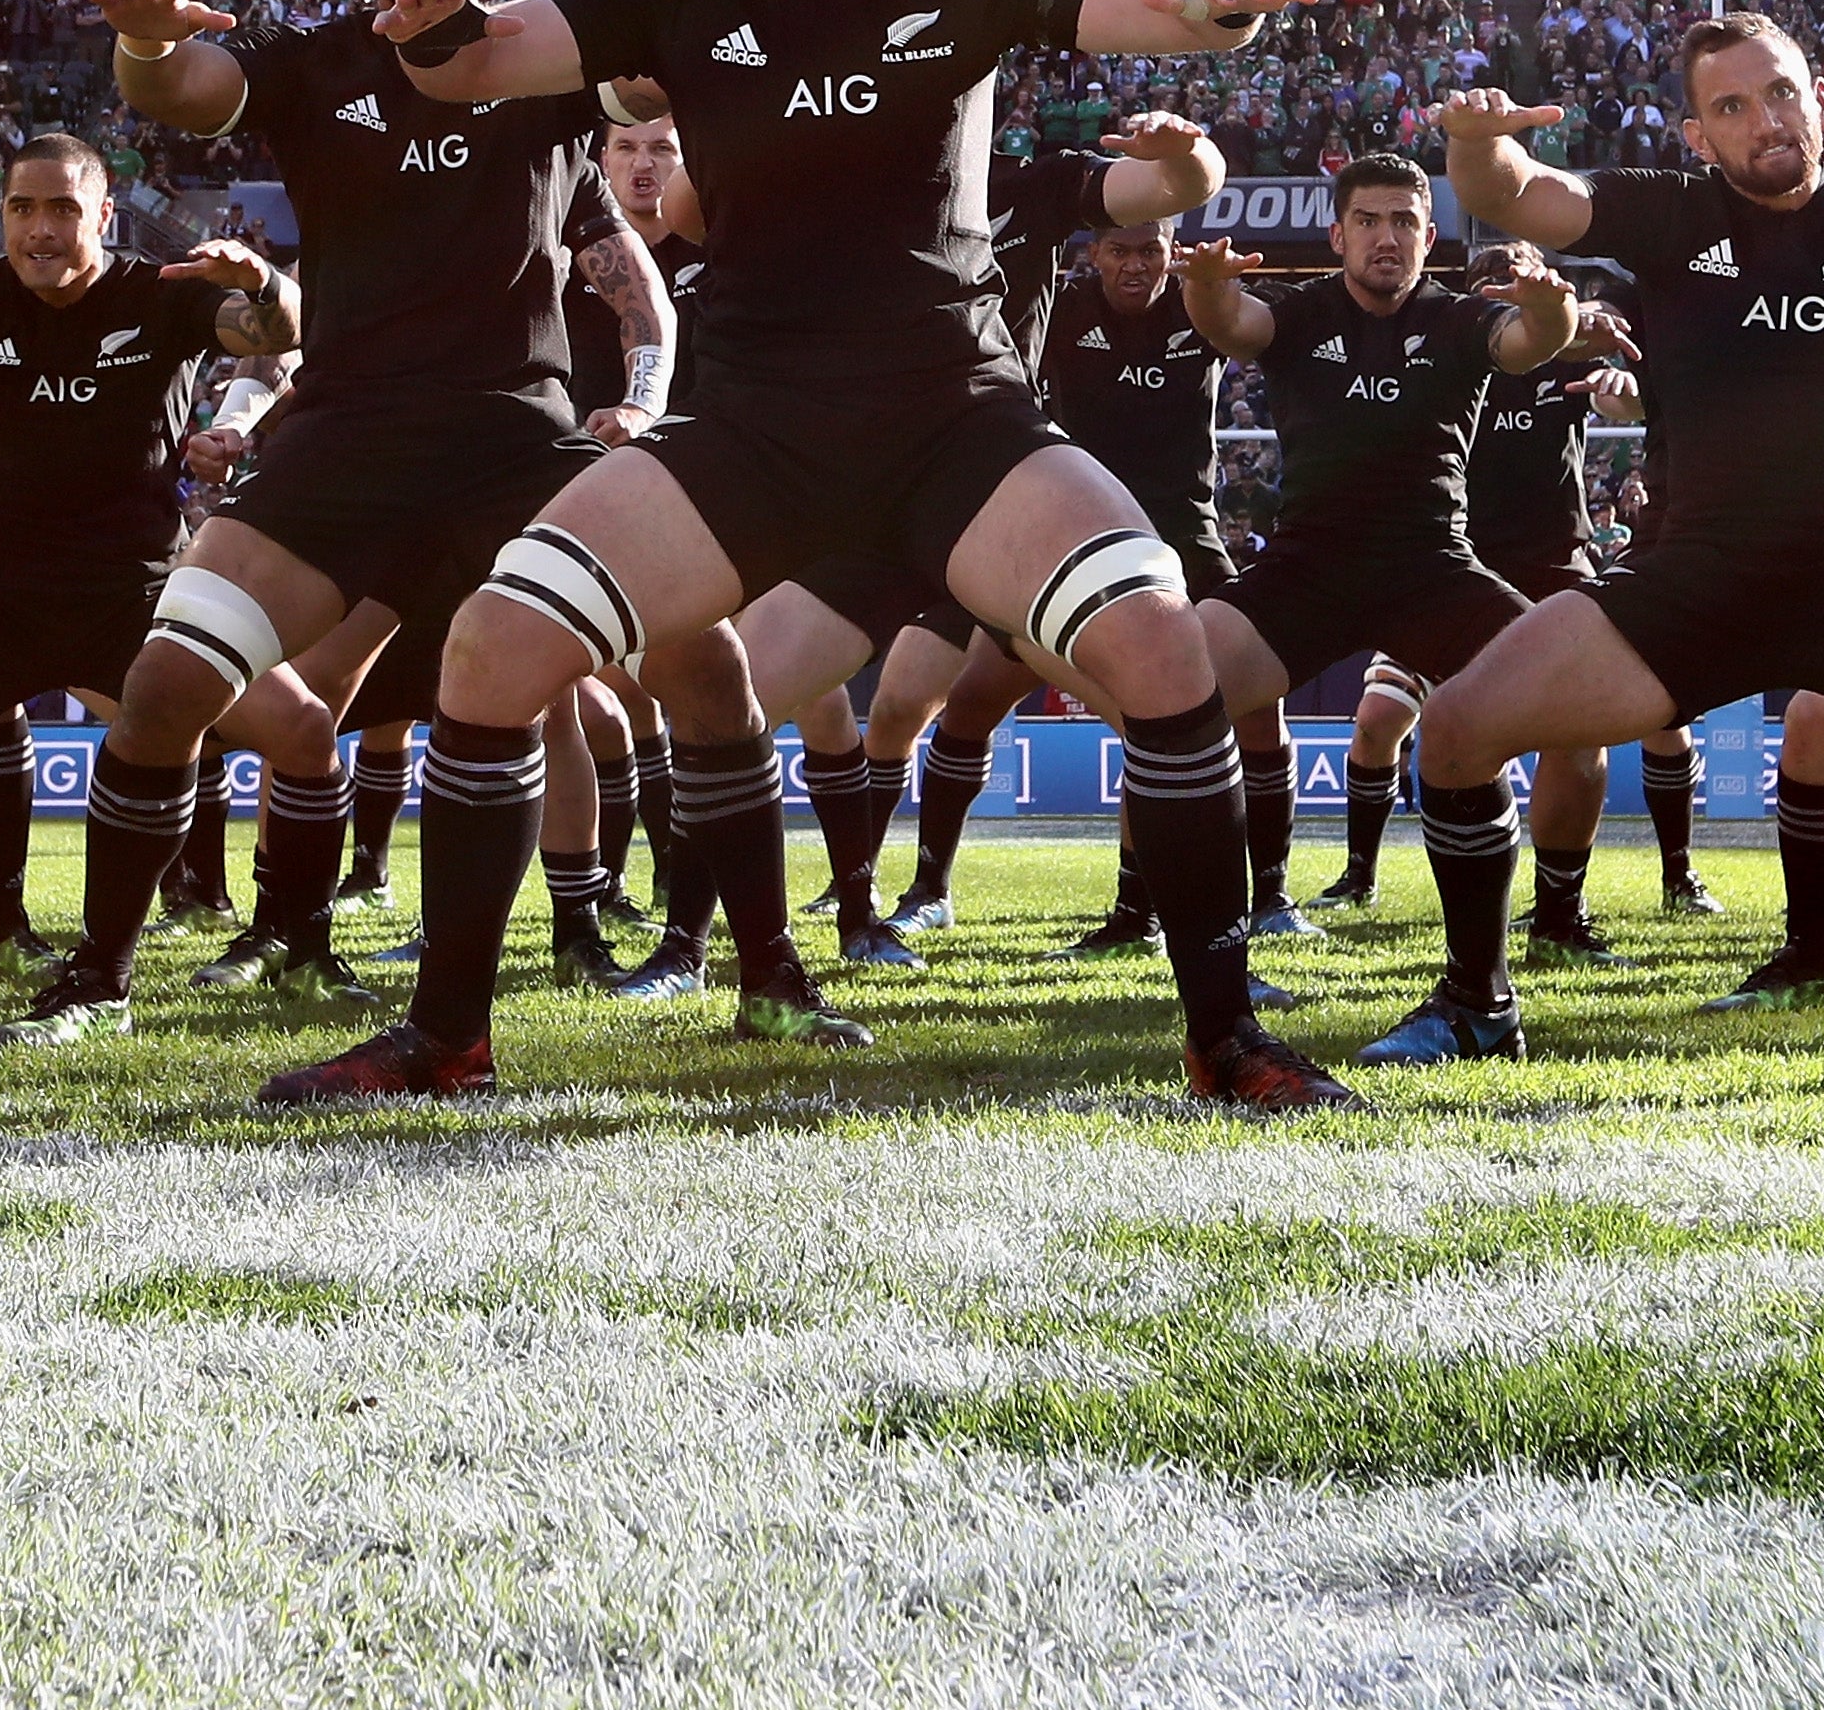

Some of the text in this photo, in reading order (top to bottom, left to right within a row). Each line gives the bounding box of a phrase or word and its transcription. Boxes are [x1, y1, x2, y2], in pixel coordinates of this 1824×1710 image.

[711, 47, 768, 66] adidas
[881, 45, 952, 63] ALL BLACKS
[784, 74, 878, 118] AIG
[335, 108, 387, 132] adidas
[400, 134, 469, 172] AIG
[1202, 186, 1336, 229] DOW
[993, 237, 1026, 253] BLACKS
[1689, 259, 1740, 278] adidas
[96, 352, 151, 368] ALL BLACKS
[1311, 348, 1348, 363] adidas
[1117, 364, 1165, 388] AIG
[29, 374, 97, 402] AIG
[1345, 374, 1400, 402] AIG
[1493, 410, 1533, 431] AIG
[1717, 734, 1743, 746] AIG
[1717, 779, 1743, 791] AIG
